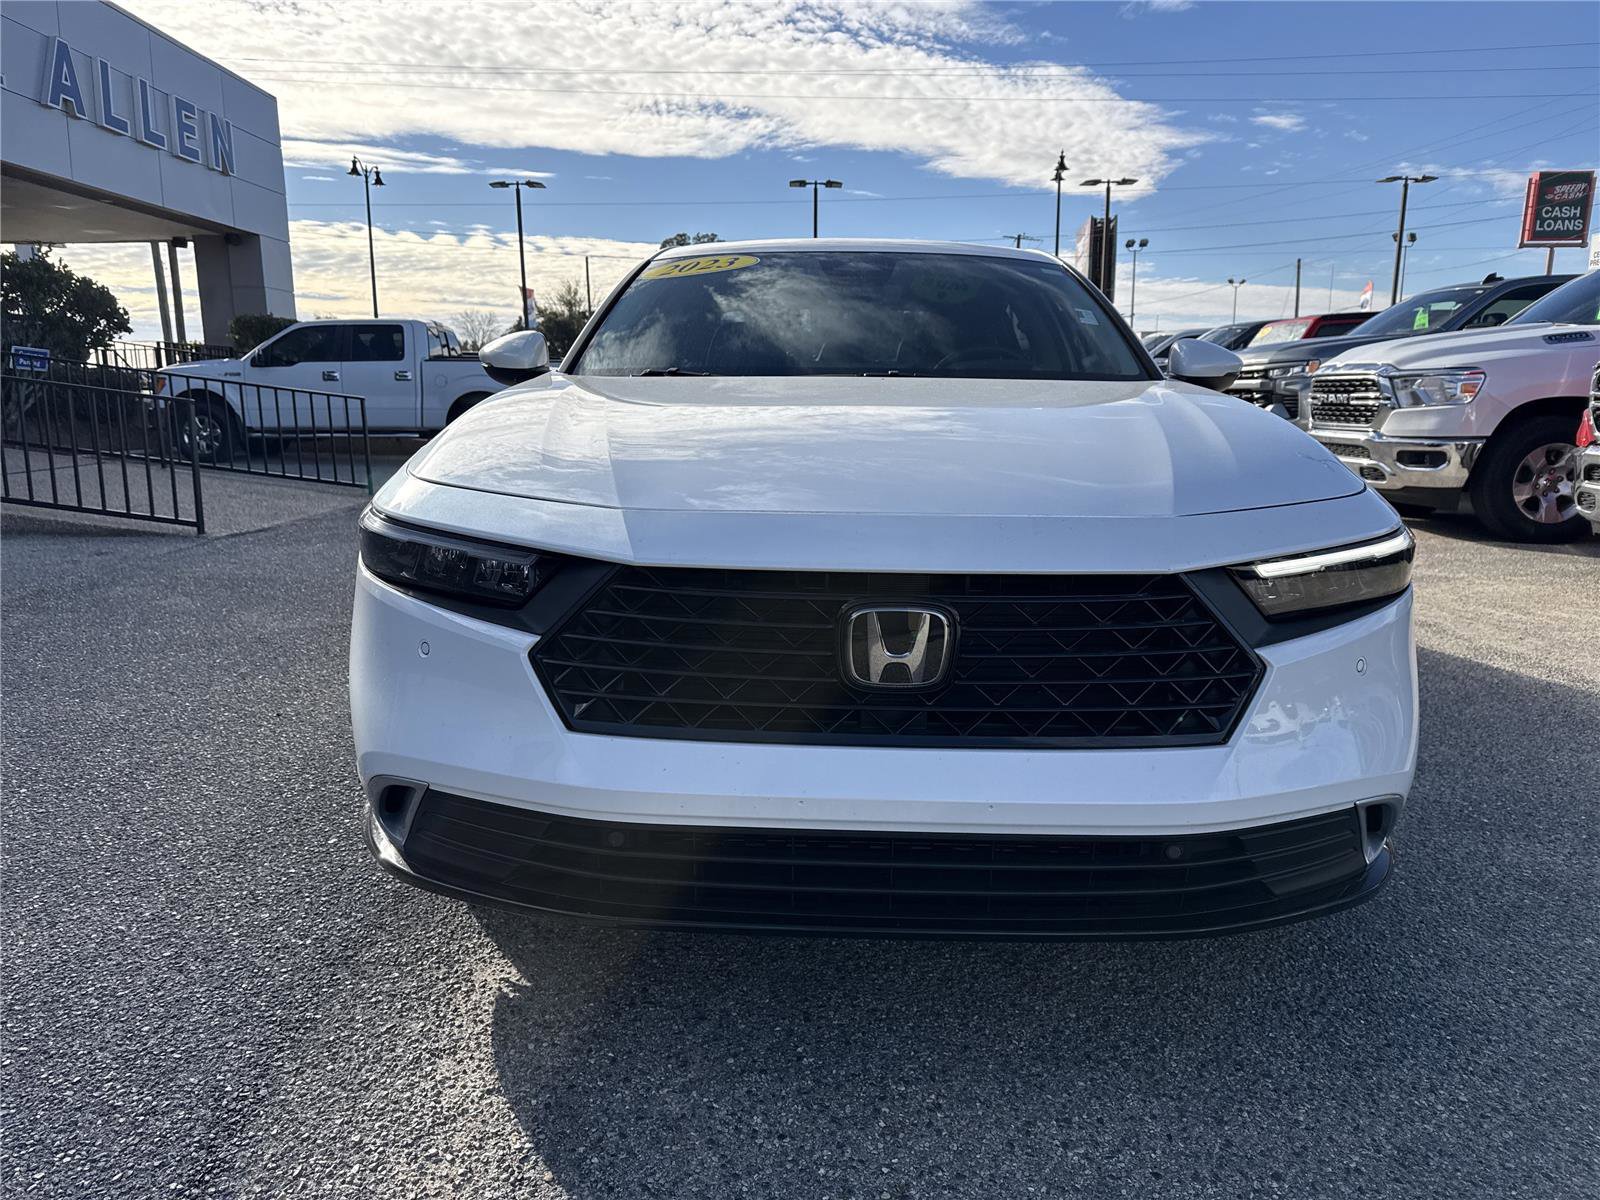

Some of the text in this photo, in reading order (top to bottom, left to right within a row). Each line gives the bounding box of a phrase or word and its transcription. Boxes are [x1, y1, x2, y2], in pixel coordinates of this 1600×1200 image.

[43, 36, 236, 176] ALLEN
[1553, 183, 1587, 194] SPEEDY
[1554, 192, 1583, 200] CASH
[1542, 206, 1581, 218] CASH
[1535, 219, 1584, 231] LOANS
[656, 257, 740, 277] 2023
[1319, 393, 1349, 404] RAM
